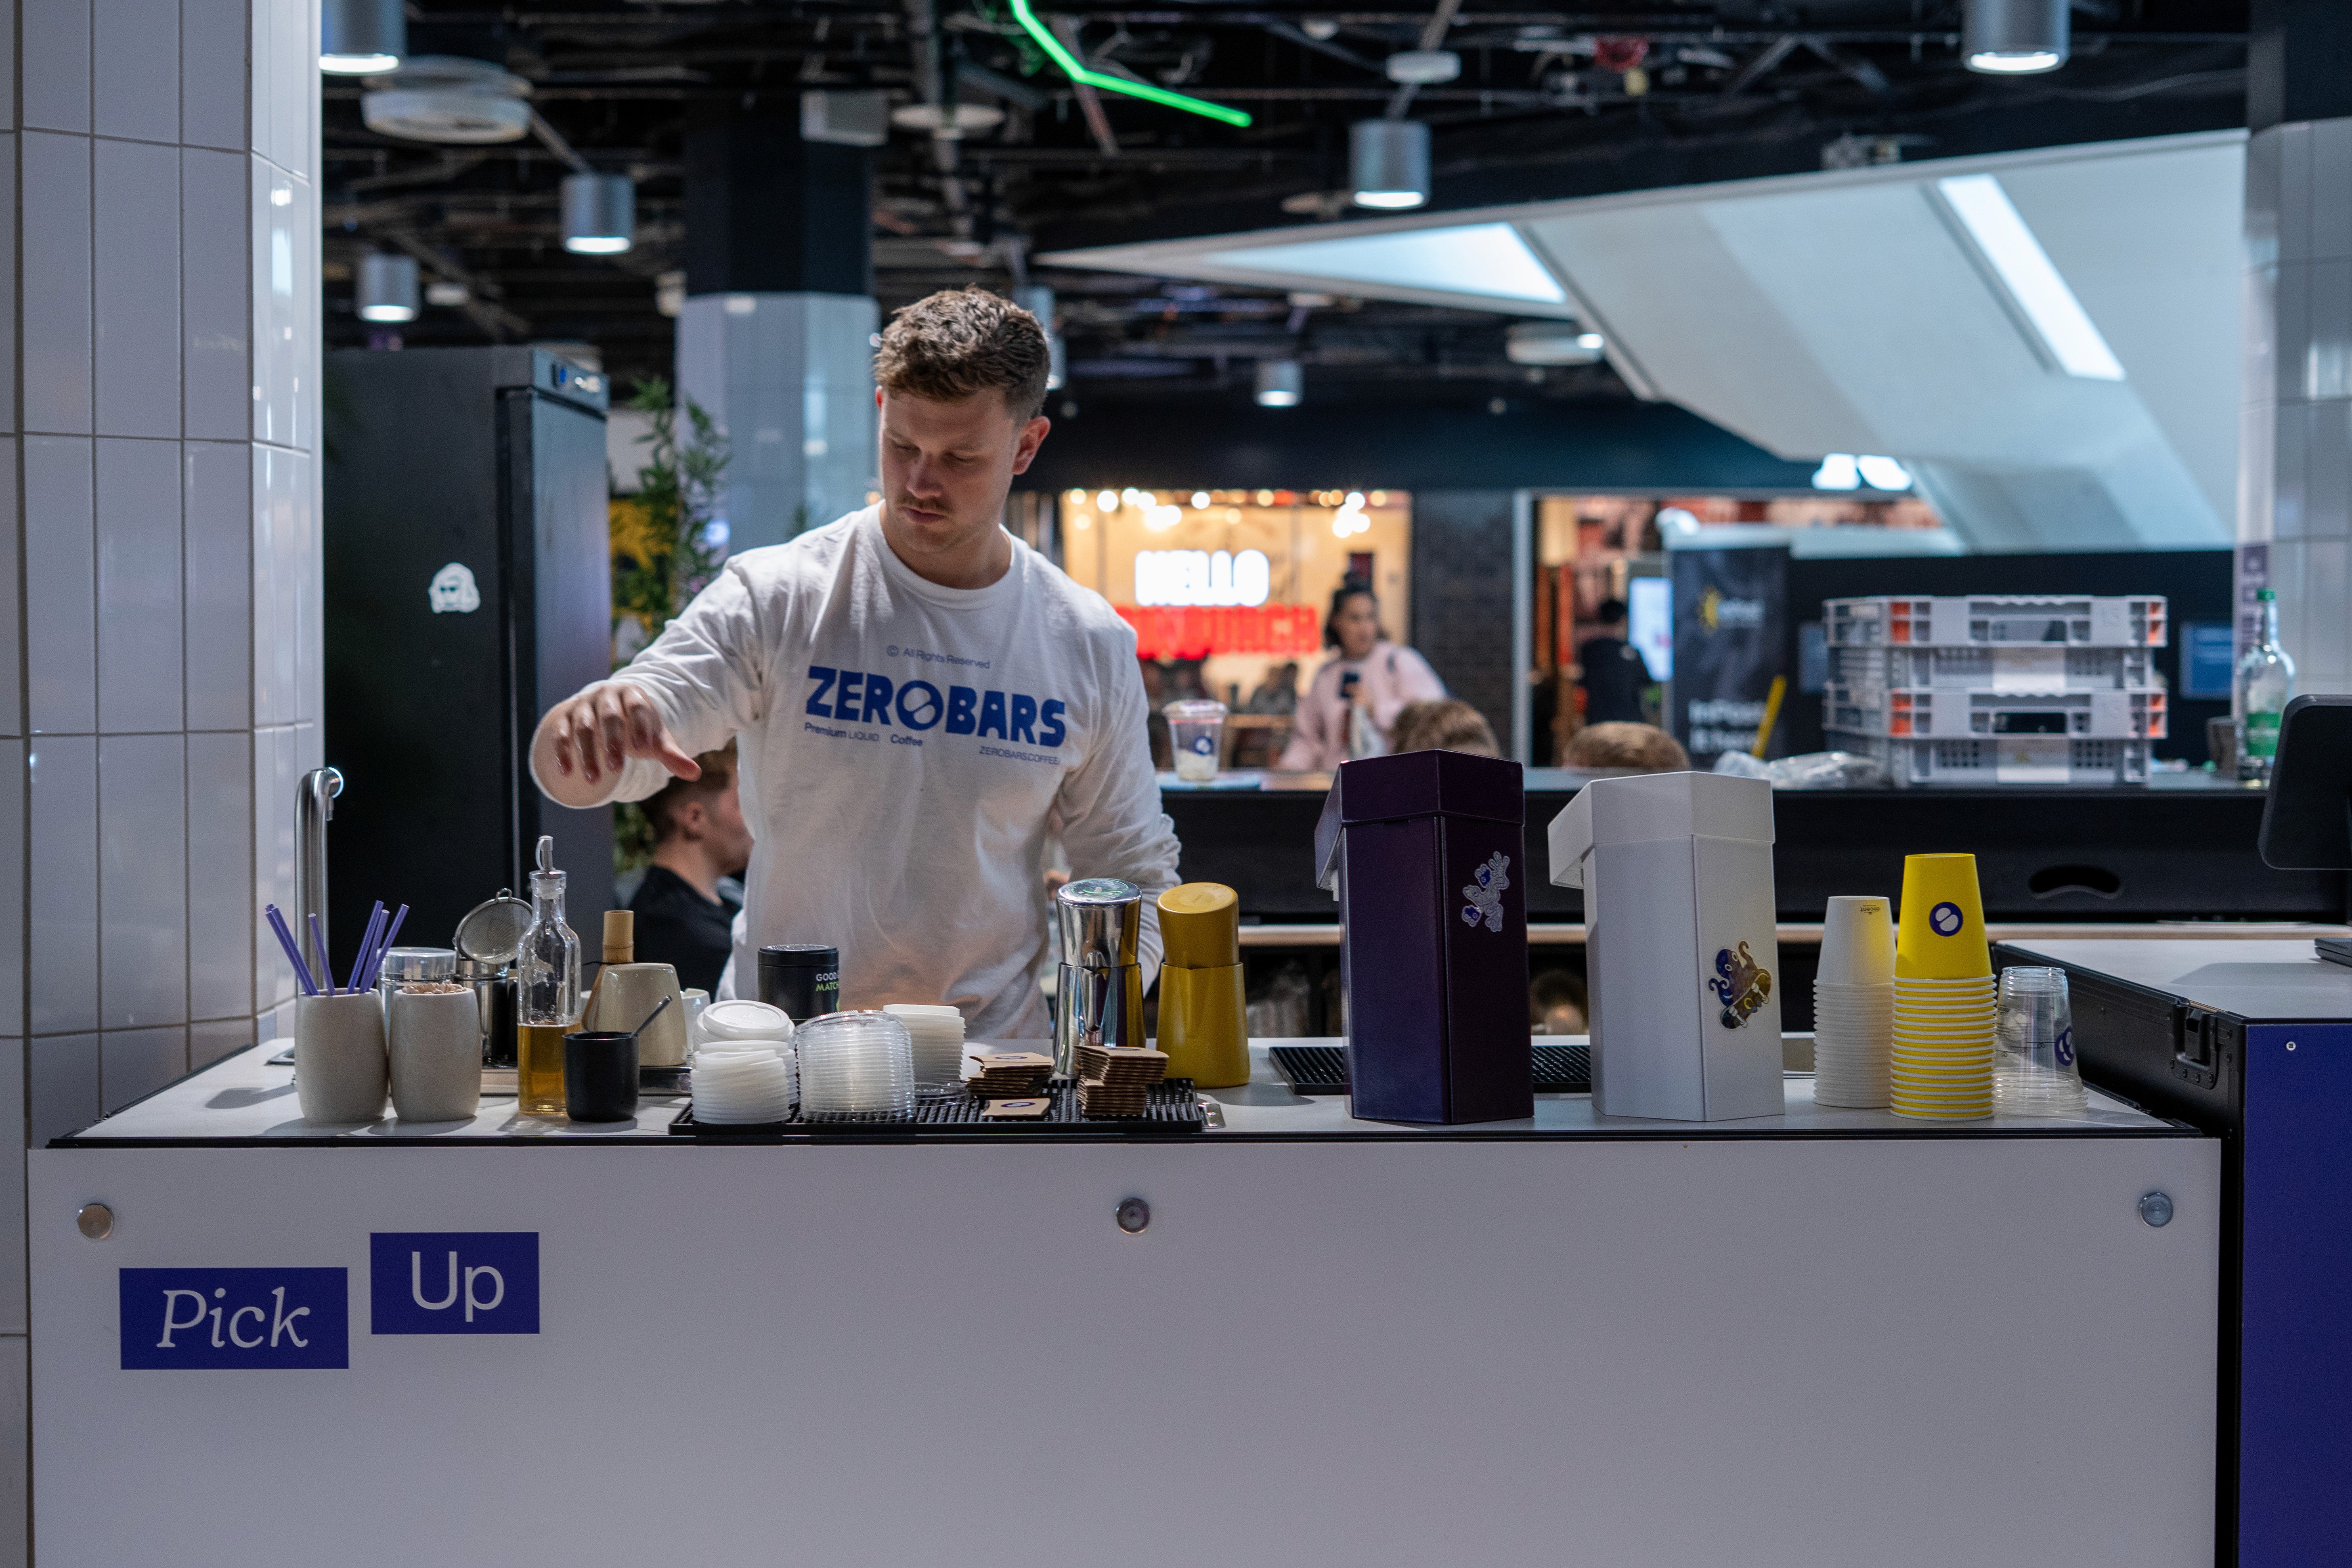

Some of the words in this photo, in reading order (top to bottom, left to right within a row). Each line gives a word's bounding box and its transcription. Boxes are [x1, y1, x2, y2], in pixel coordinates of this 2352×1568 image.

[903, 648, 915, 657] All
[916, 650, 945, 662] Rights
[946, 654, 990, 669] Reserved
[806, 666, 1065, 747] ZEROBARS
[805, 722, 847, 738] Premium
[849, 730, 879, 742] LIQUID
[890, 734, 922, 746] Coffee
[815, 972, 837, 981] GOOD
[157, 1287, 310, 1348] Pick
[412, 1251, 504, 1322] Up
